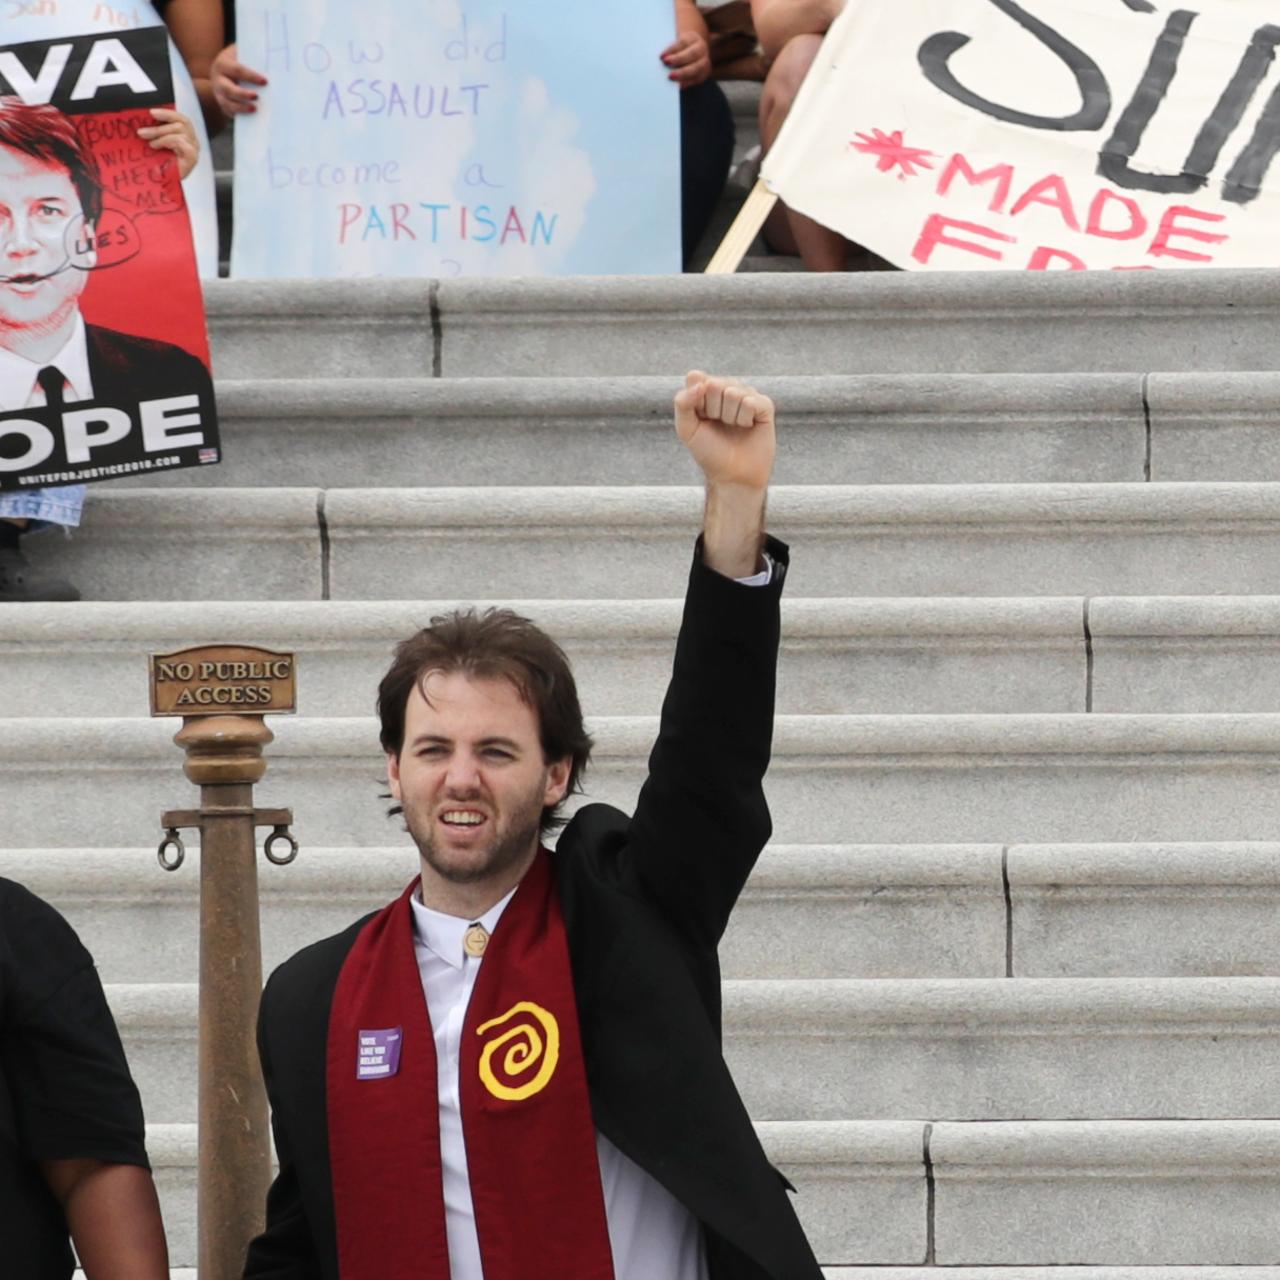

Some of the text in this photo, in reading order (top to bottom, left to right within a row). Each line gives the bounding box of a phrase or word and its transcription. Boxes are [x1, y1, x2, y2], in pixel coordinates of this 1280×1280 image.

[263, 9, 509, 73] How did
[0, 37, 159, 110] VA
[321, 79, 490, 120] ASSAULT
[267, 147, 504, 191] become a
[336, 202, 559, 248] PARTISAN
[0, 393, 205, 473] OPE
[158, 659, 290, 682] NO PUBLIC
[176, 684, 273, 706] ACCESS
